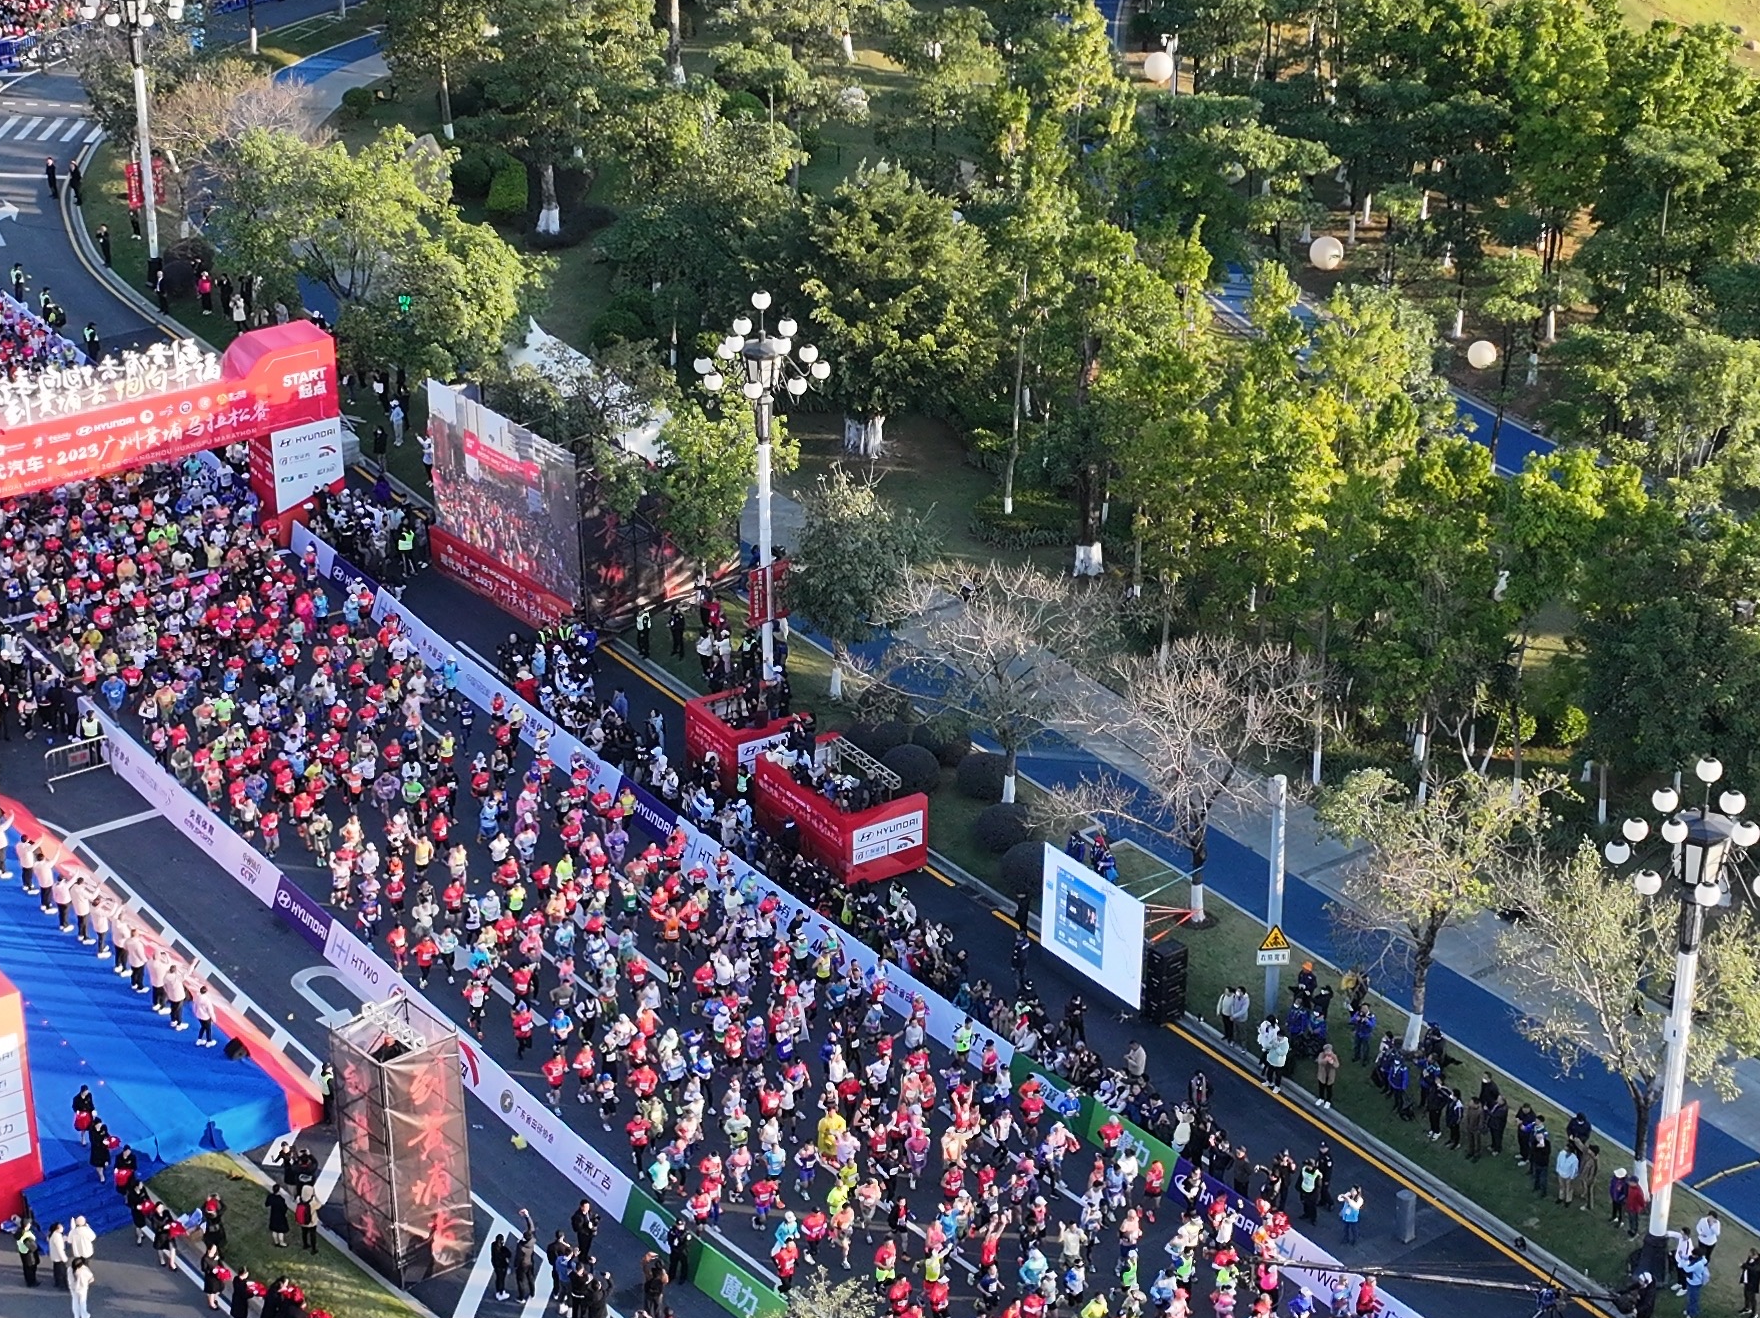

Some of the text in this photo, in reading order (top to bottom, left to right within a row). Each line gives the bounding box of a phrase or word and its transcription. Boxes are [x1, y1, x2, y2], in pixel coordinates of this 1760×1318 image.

[283, 367, 327, 387] START
[298, 381, 327, 400] 起点
[93, 416, 136, 432] HYUNDAI
[214, 427, 258, 442] MARATHON
[295, 428, 336, 444] HYUNDAI
[634, 802, 676, 836] HYUNDAI
[876, 817, 918, 836] HYUNDAI
[240, 866, 257, 885] CCTV
[291, 901, 328, 941] HYUNDAI
[350, 955, 379, 984] HTWO
[514, 1105, 556, 1145] 广东省田径协会
[720, 1273, 759, 1318] 魔力
